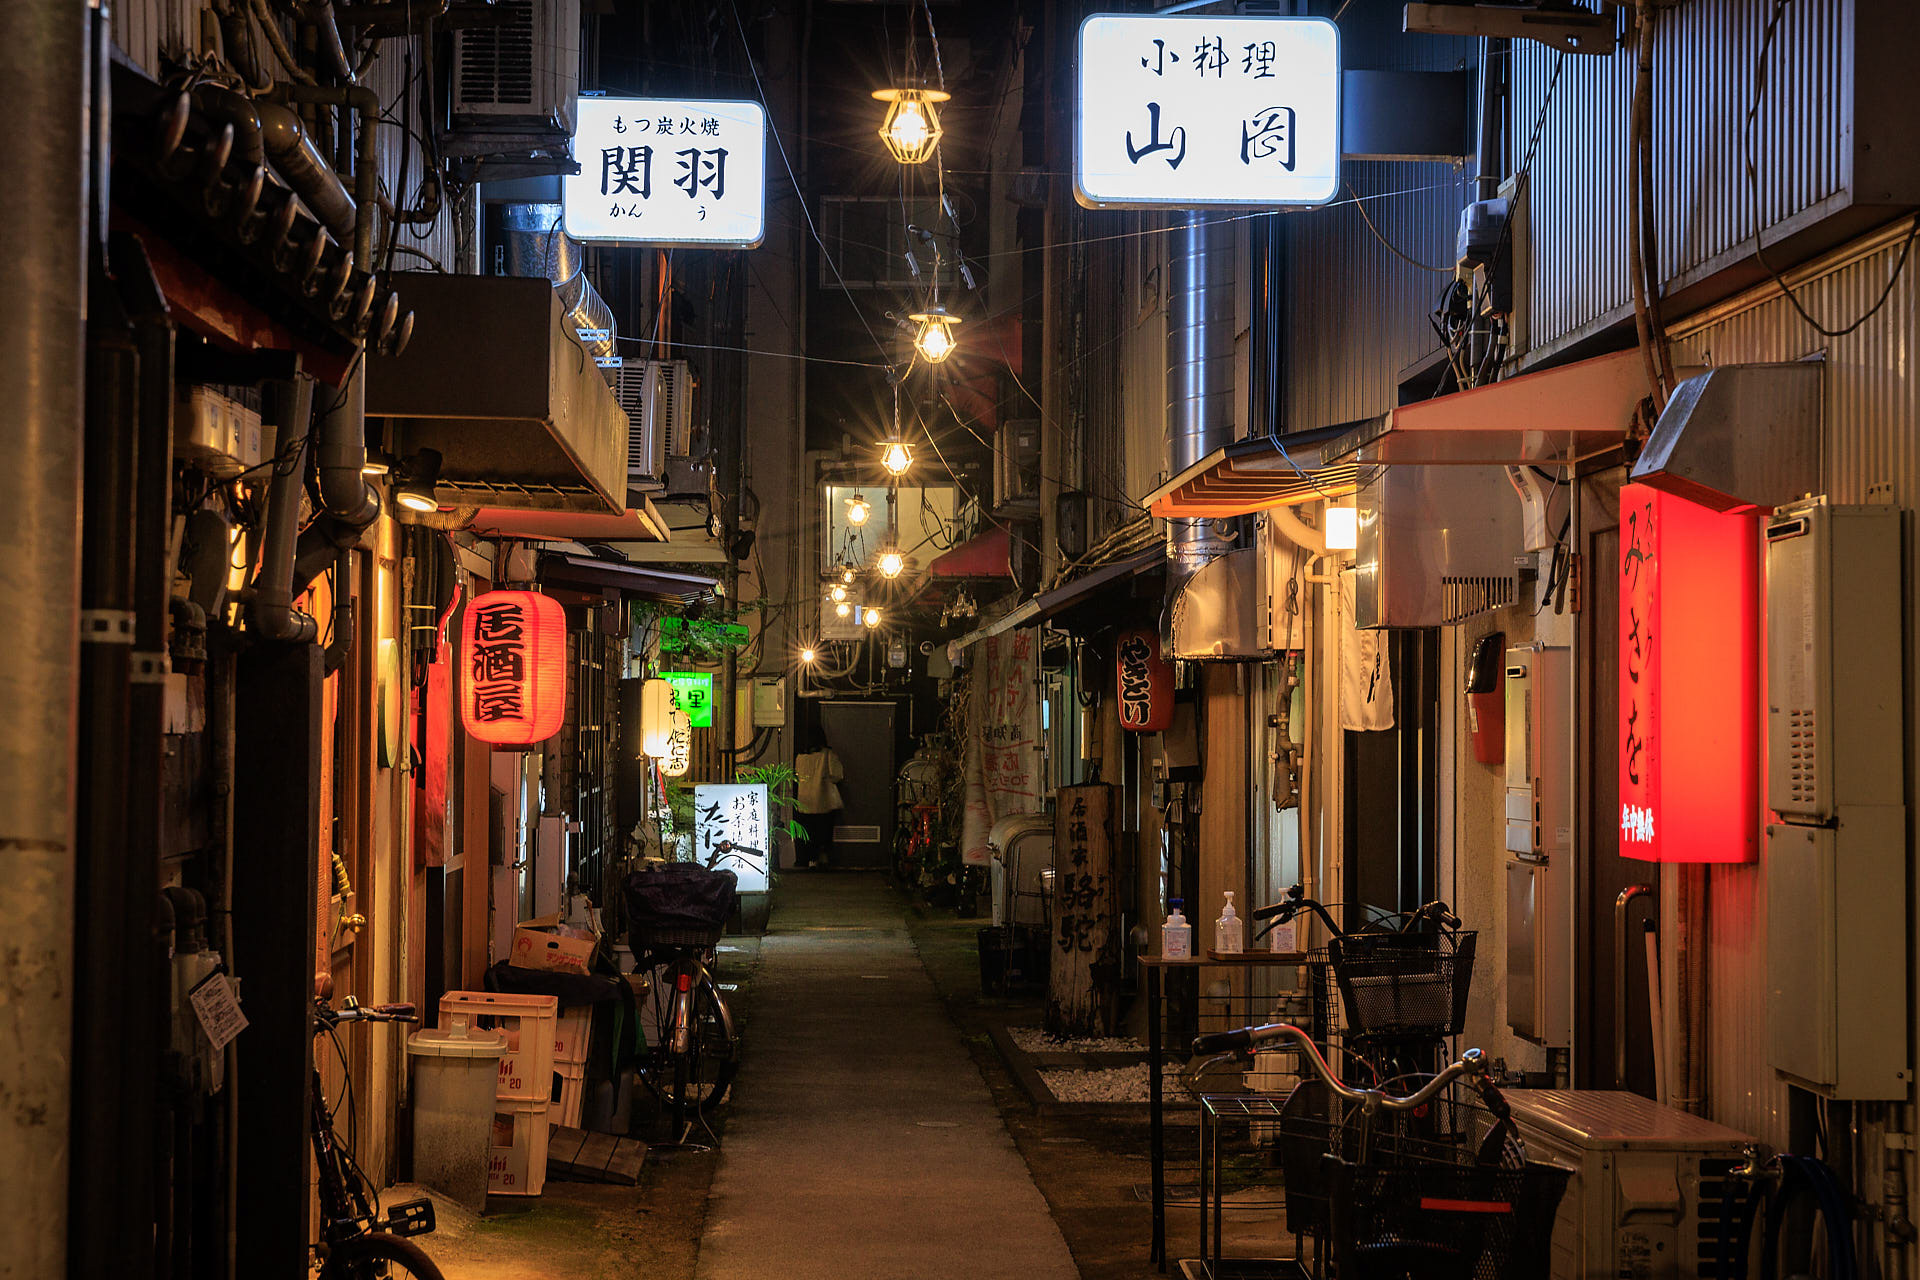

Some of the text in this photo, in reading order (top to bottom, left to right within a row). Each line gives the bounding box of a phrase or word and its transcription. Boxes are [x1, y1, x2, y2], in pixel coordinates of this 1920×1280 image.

[1141, 36, 1276, 80] 小料理
[612, 115, 720, 136] もつ炭火焼
[1125, 102, 1296, 172] 山岡
[600, 144, 730, 200] 関羽
[609, 202, 708, 221] かん う
[472, 602, 525, 722] 居酒屋
[1120, 636, 1152, 726] やきとり
[1621, 803, 1655, 844] 年中無休
[509, 1078, 522, 1090] 20
[503, 1173, 515, 1186] 20
